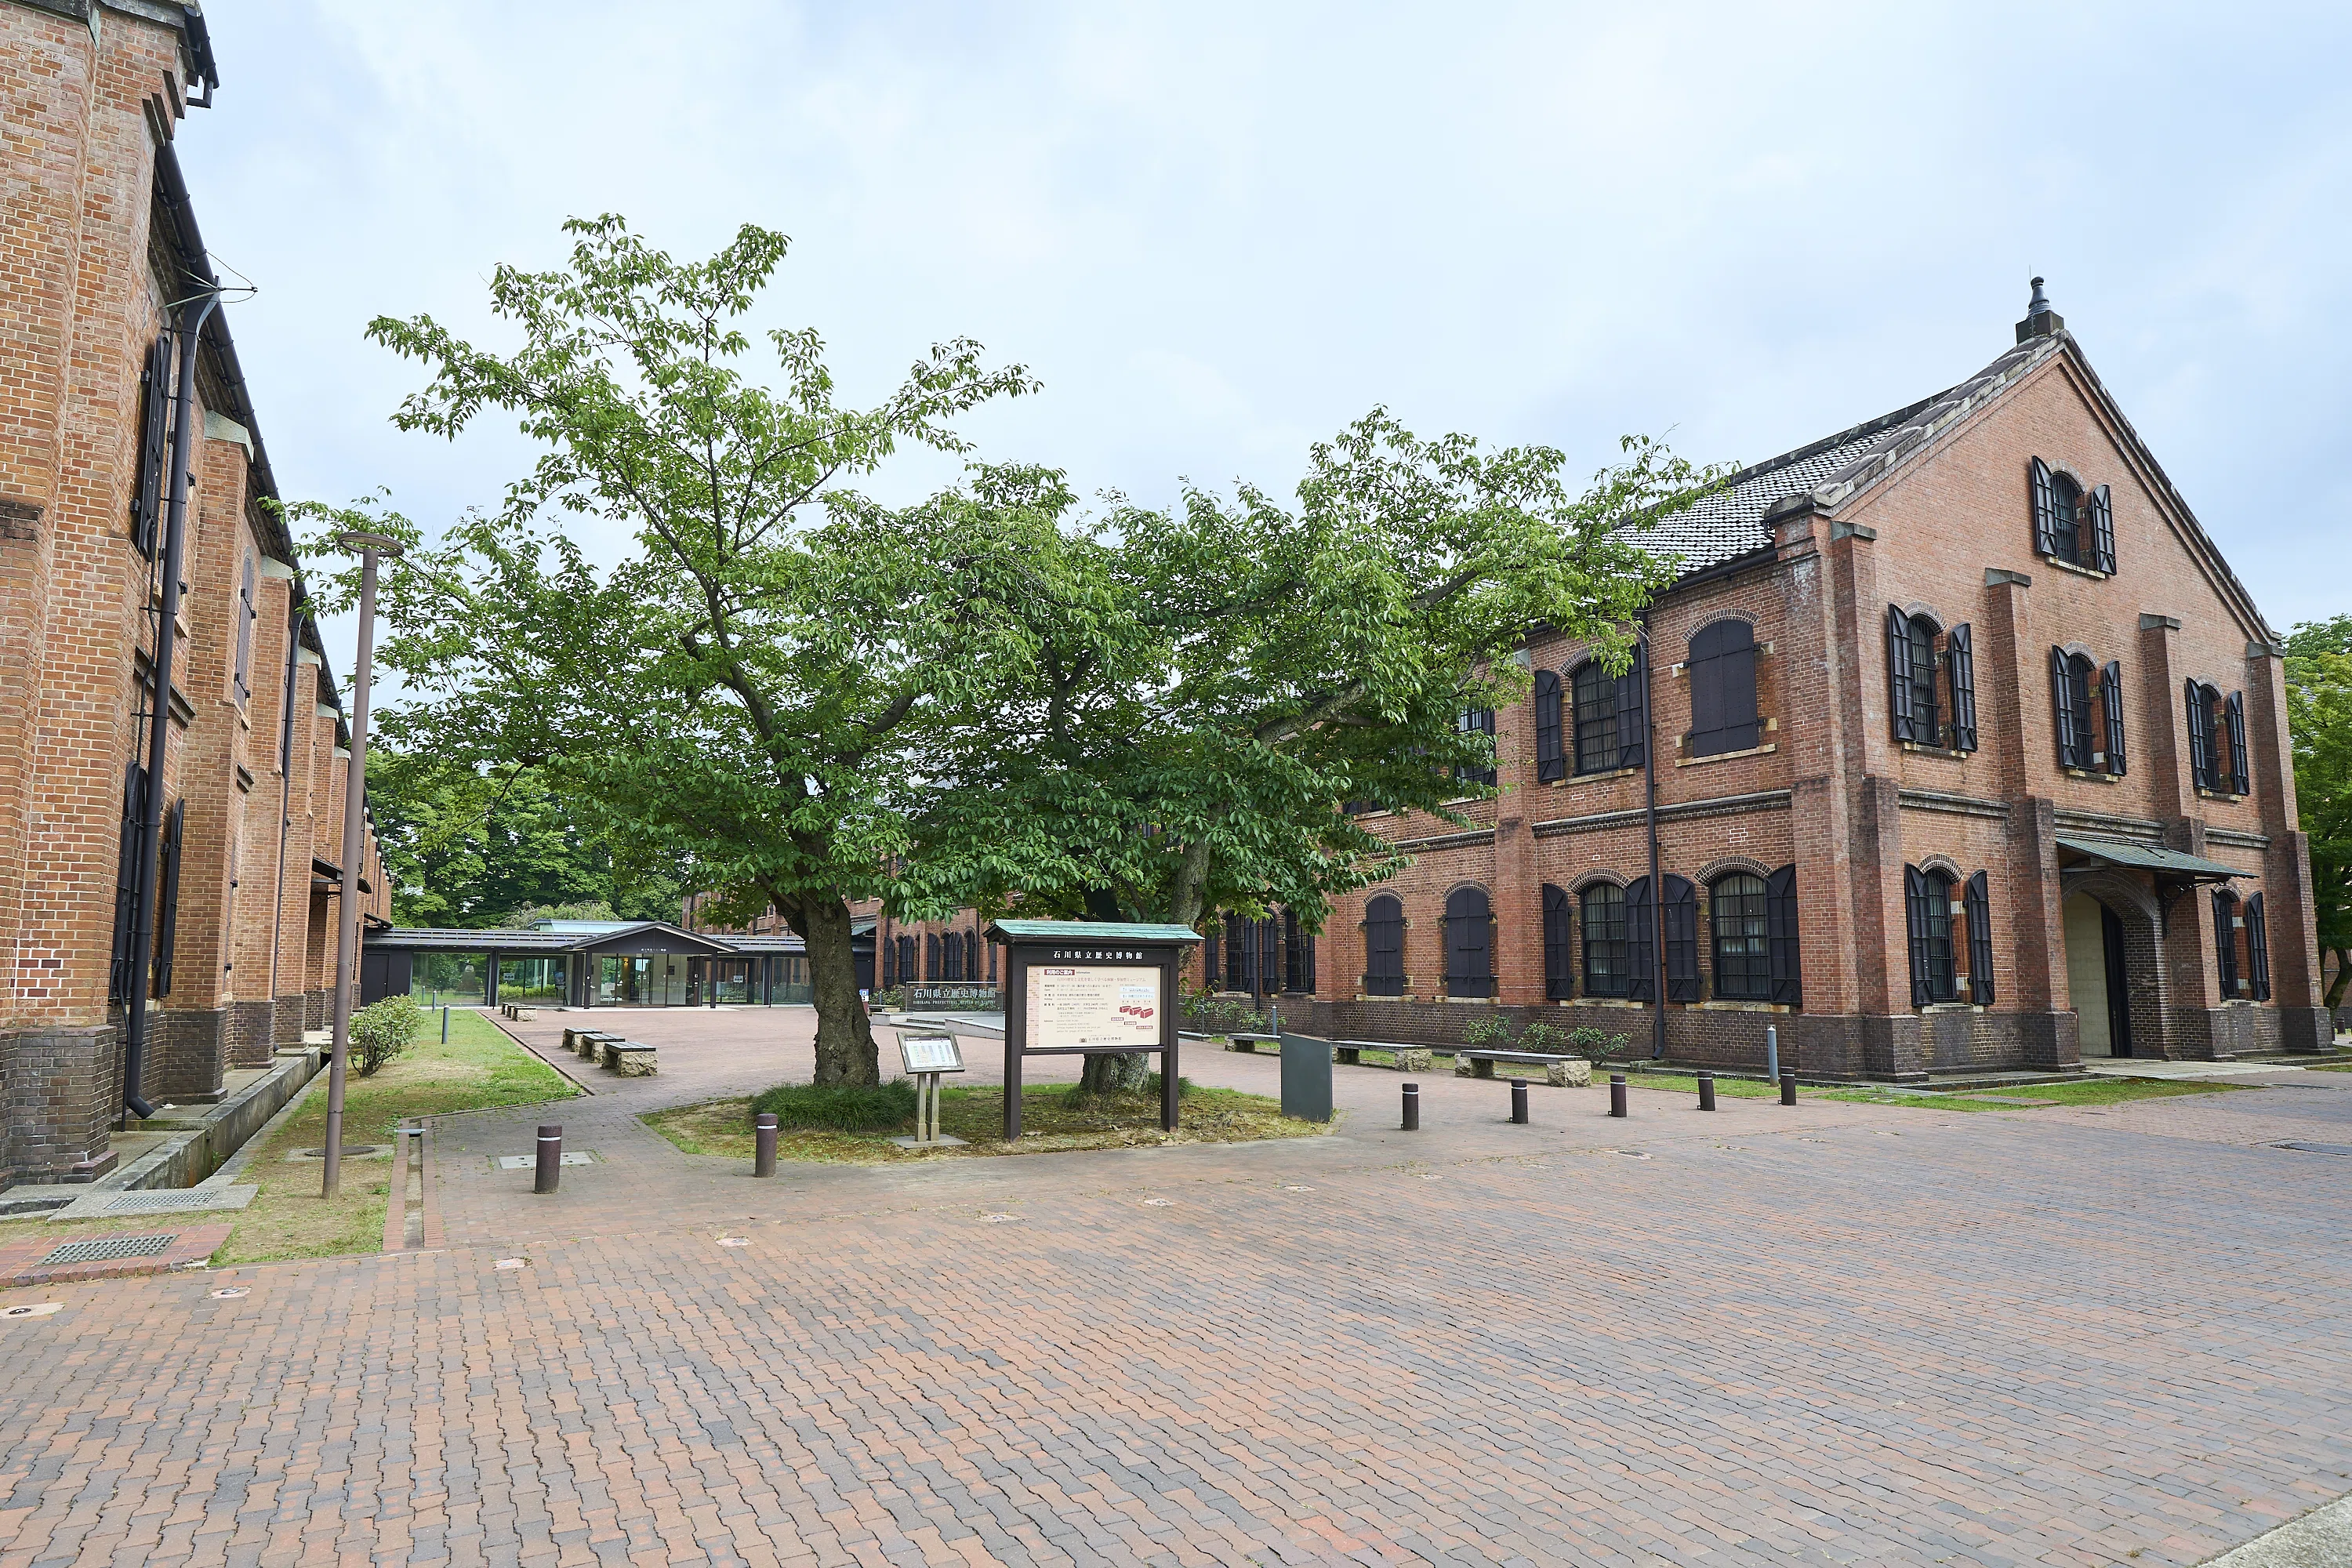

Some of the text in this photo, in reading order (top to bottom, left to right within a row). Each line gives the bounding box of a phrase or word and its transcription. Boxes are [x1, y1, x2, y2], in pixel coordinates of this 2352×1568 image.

[1053, 950, 1143, 960] 石川県立歴史博物館
[913, 989, 996, 998] 石川県立歴史博物館
